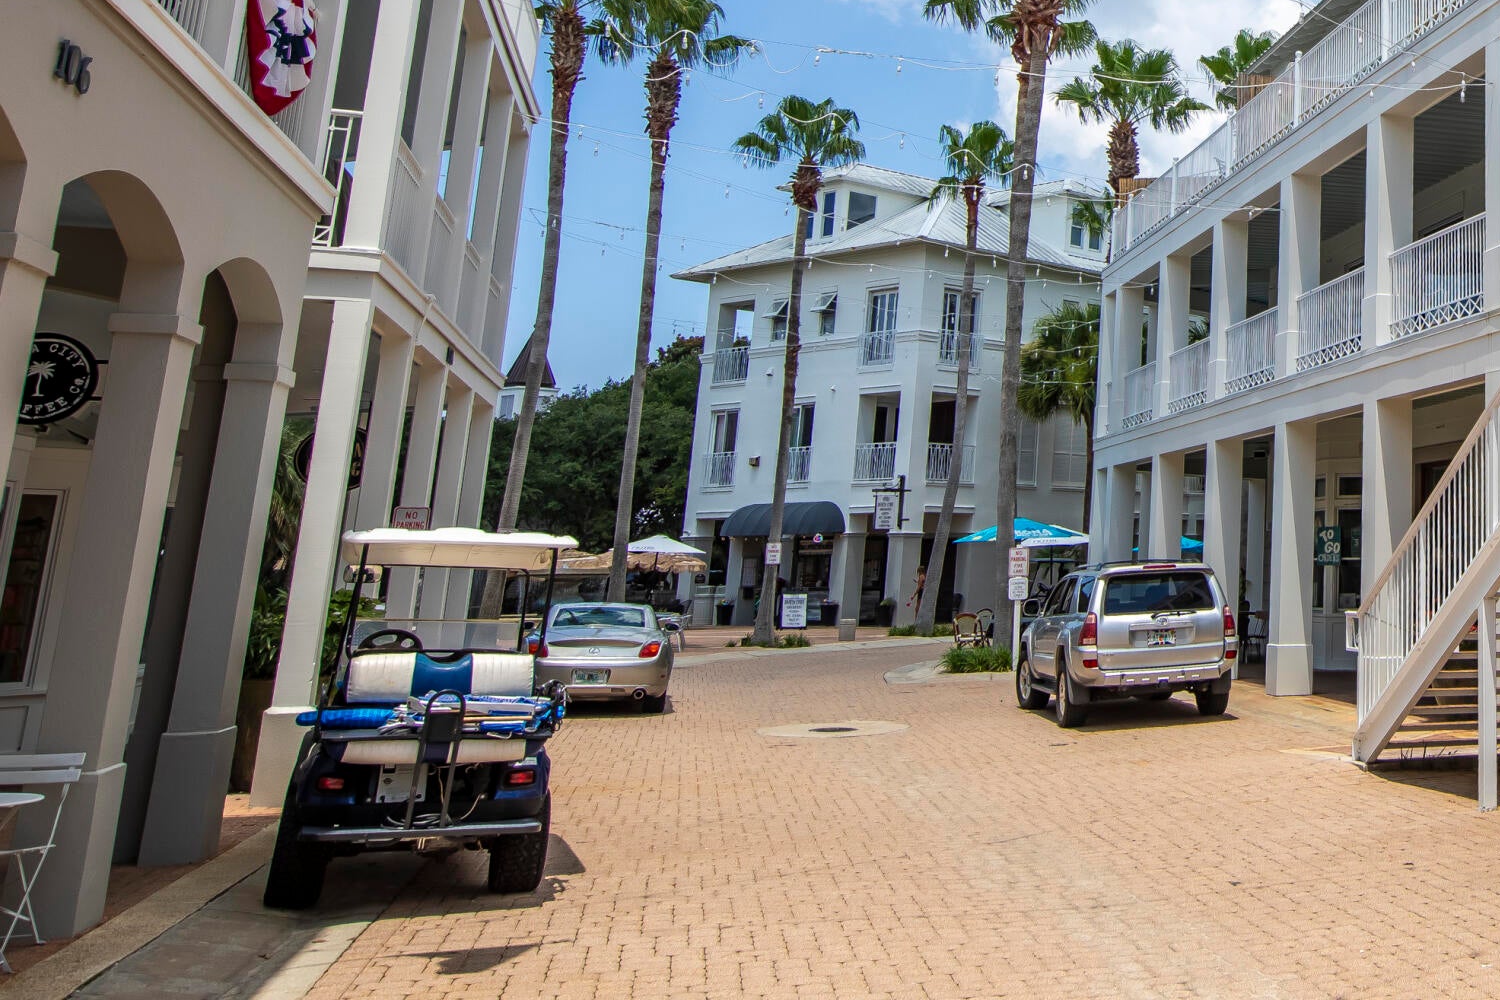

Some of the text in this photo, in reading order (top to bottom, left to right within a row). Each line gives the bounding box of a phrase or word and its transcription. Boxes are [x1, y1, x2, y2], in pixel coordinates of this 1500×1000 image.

[54, 39, 93, 95] 106
[49, 344, 85, 368] CITY
[22, 397, 68, 414] FFEE
[405, 511, 418, 520] NO
[1319, 529, 1335, 543] TO
[1324, 541, 1341, 554] GO
